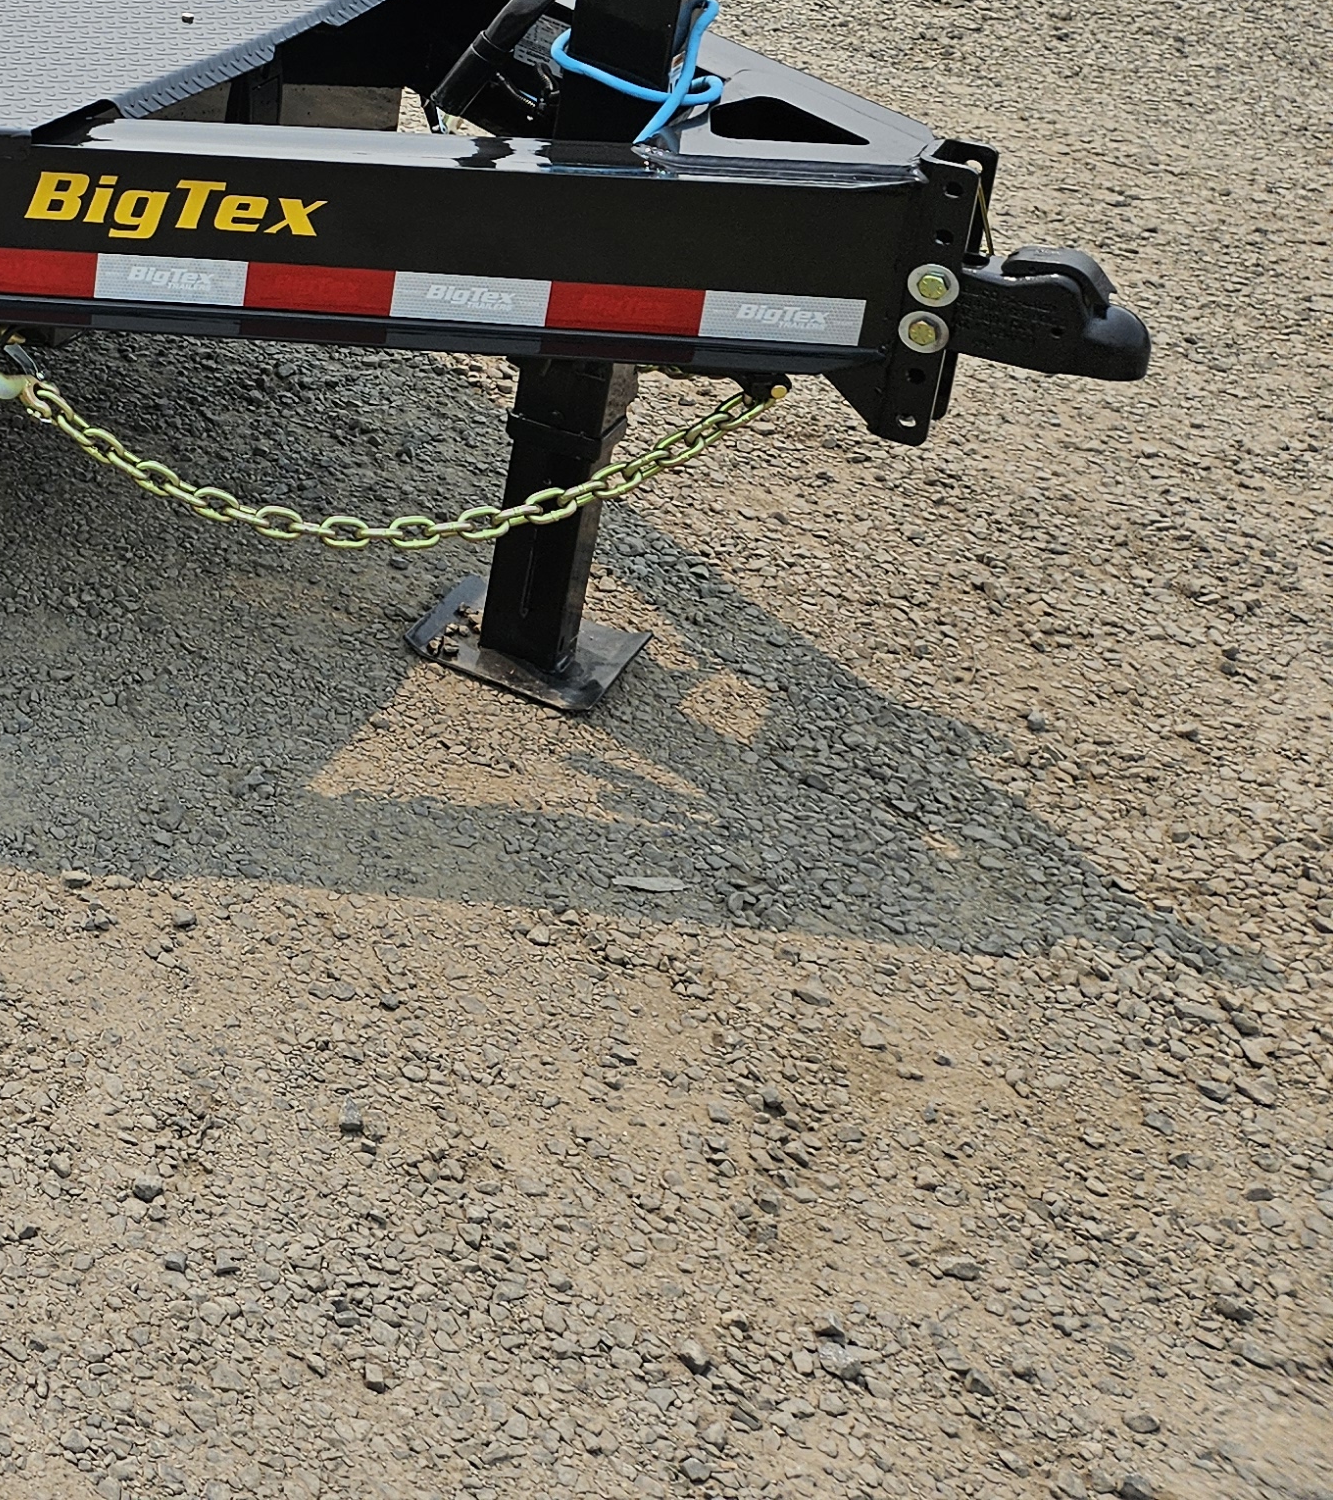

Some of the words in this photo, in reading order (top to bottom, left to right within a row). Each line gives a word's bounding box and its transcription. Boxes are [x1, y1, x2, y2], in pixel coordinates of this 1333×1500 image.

[24, 170, 328, 239] BigTex
[127, 266, 214, 286] BigTex
[426, 284, 516, 305] BigTex
[735, 303, 830, 325] BigTex
